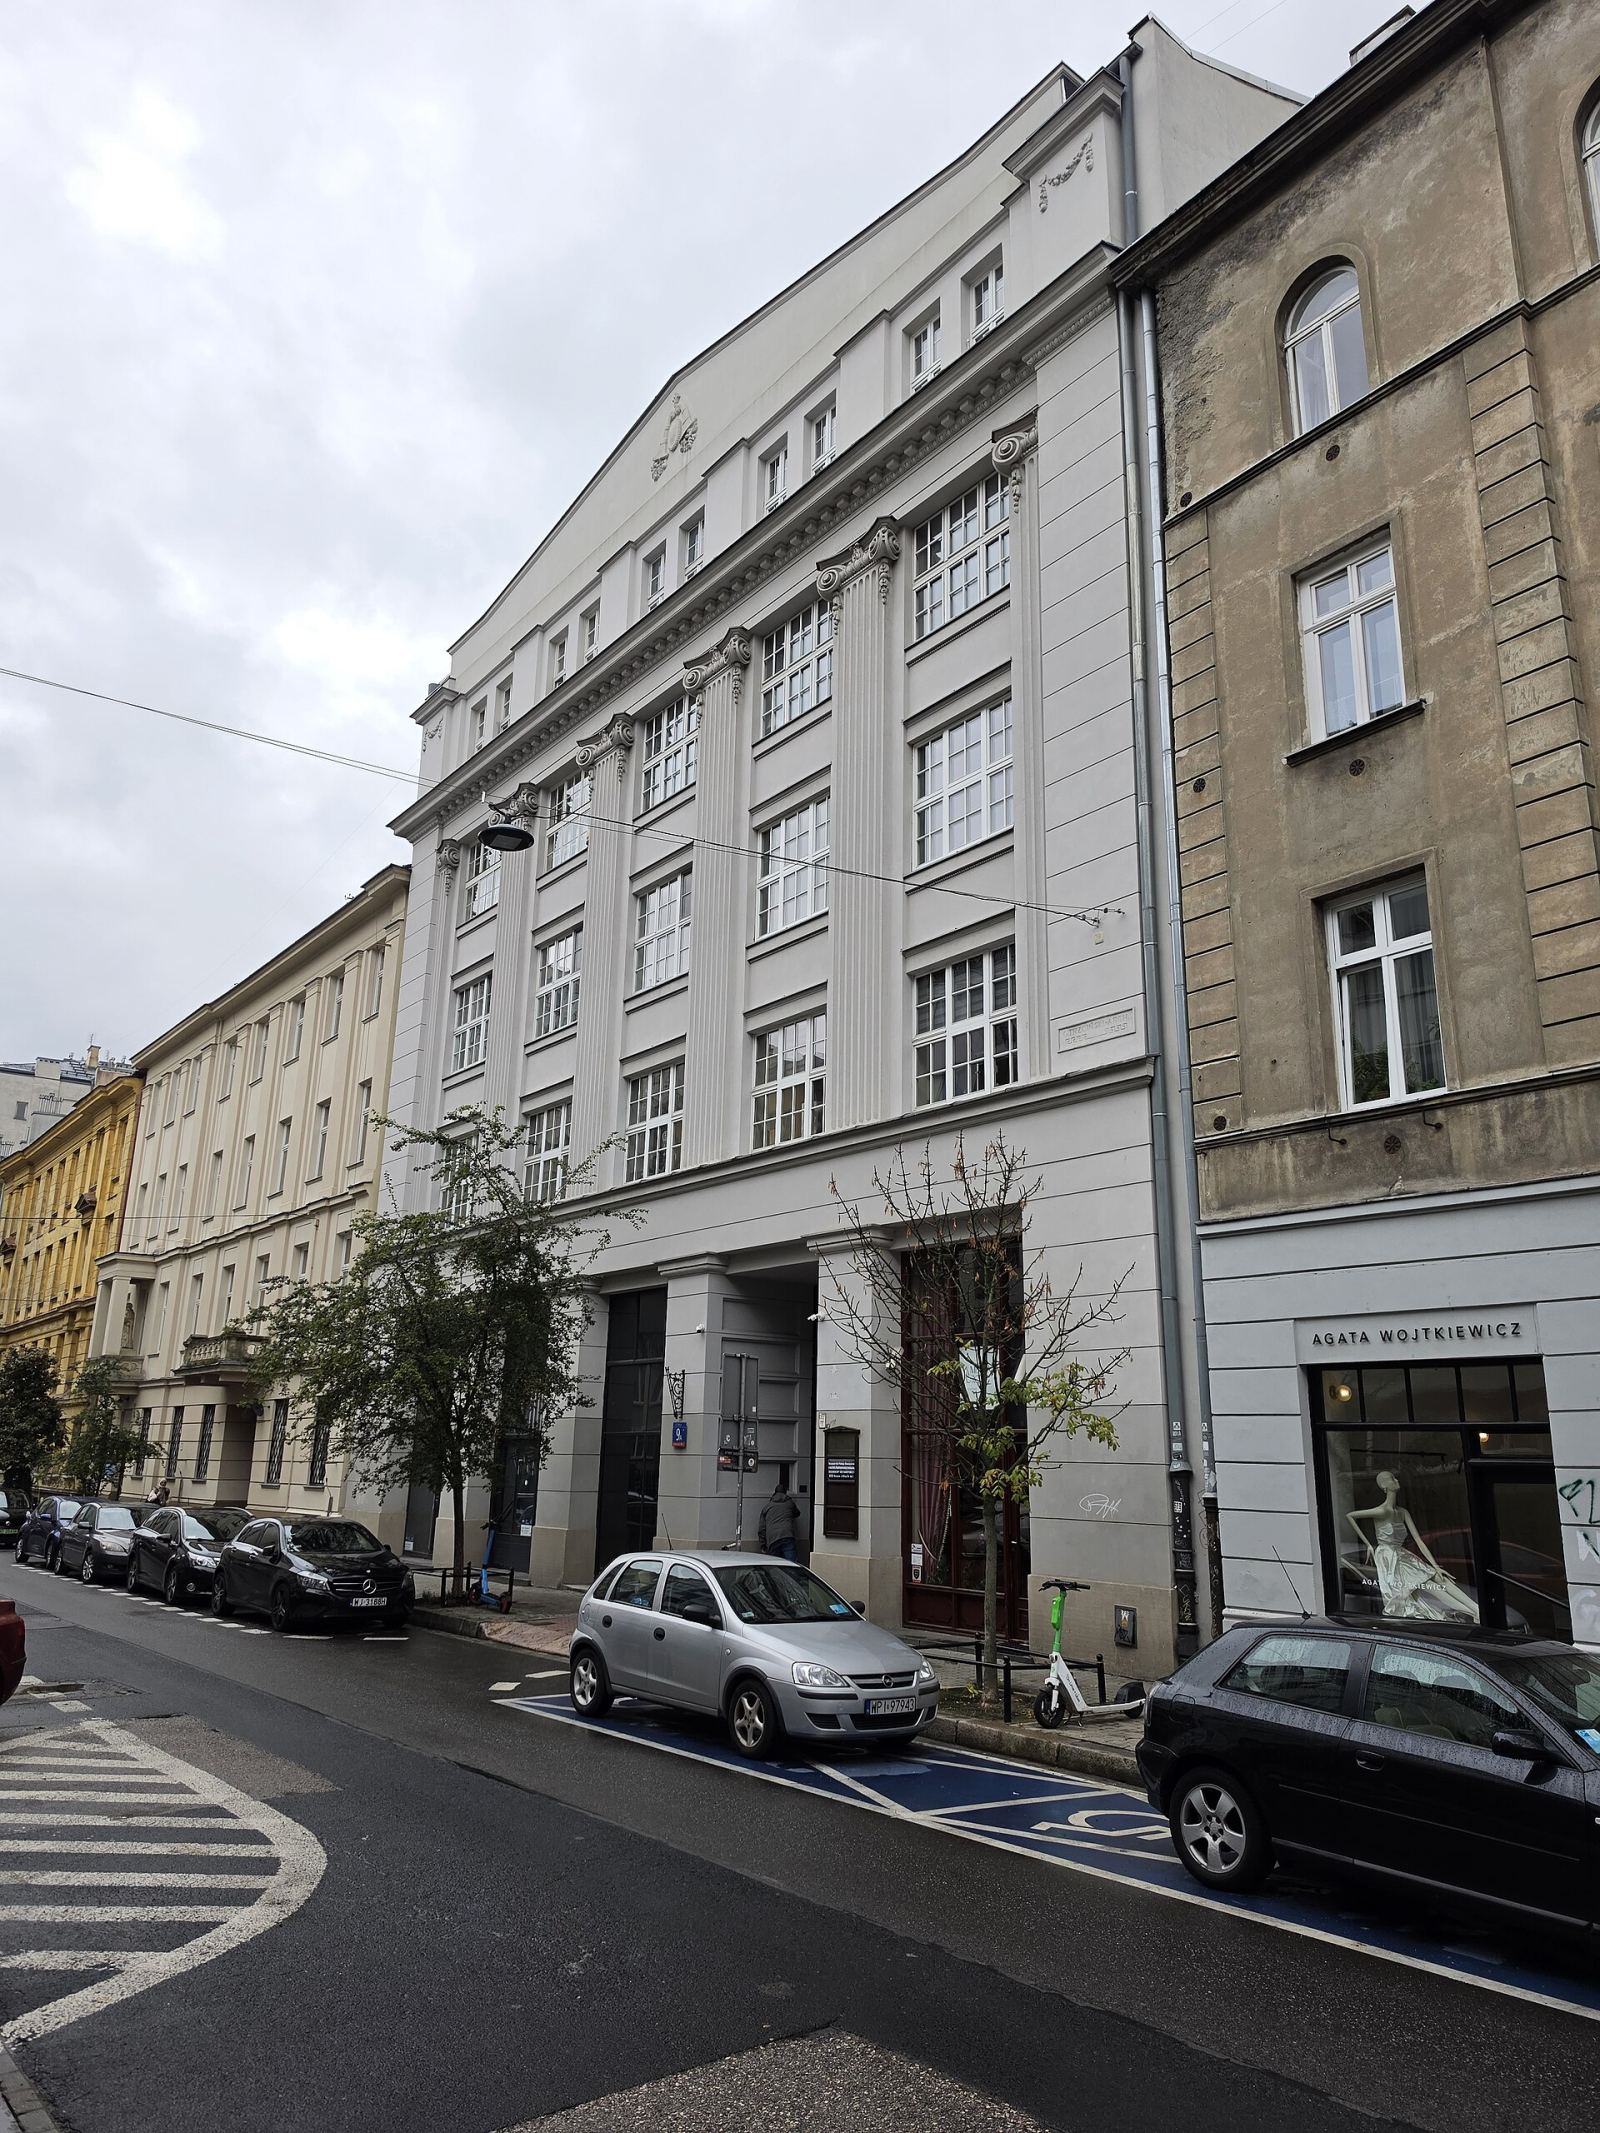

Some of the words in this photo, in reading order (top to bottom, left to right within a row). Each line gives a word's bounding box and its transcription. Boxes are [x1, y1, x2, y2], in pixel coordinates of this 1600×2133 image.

[1312, 1331, 1370, 1345] AGATA
[1380, 1322, 1521, 1342] WOJTKIEWICZ
[890, 1699, 915, 1712] 97943
